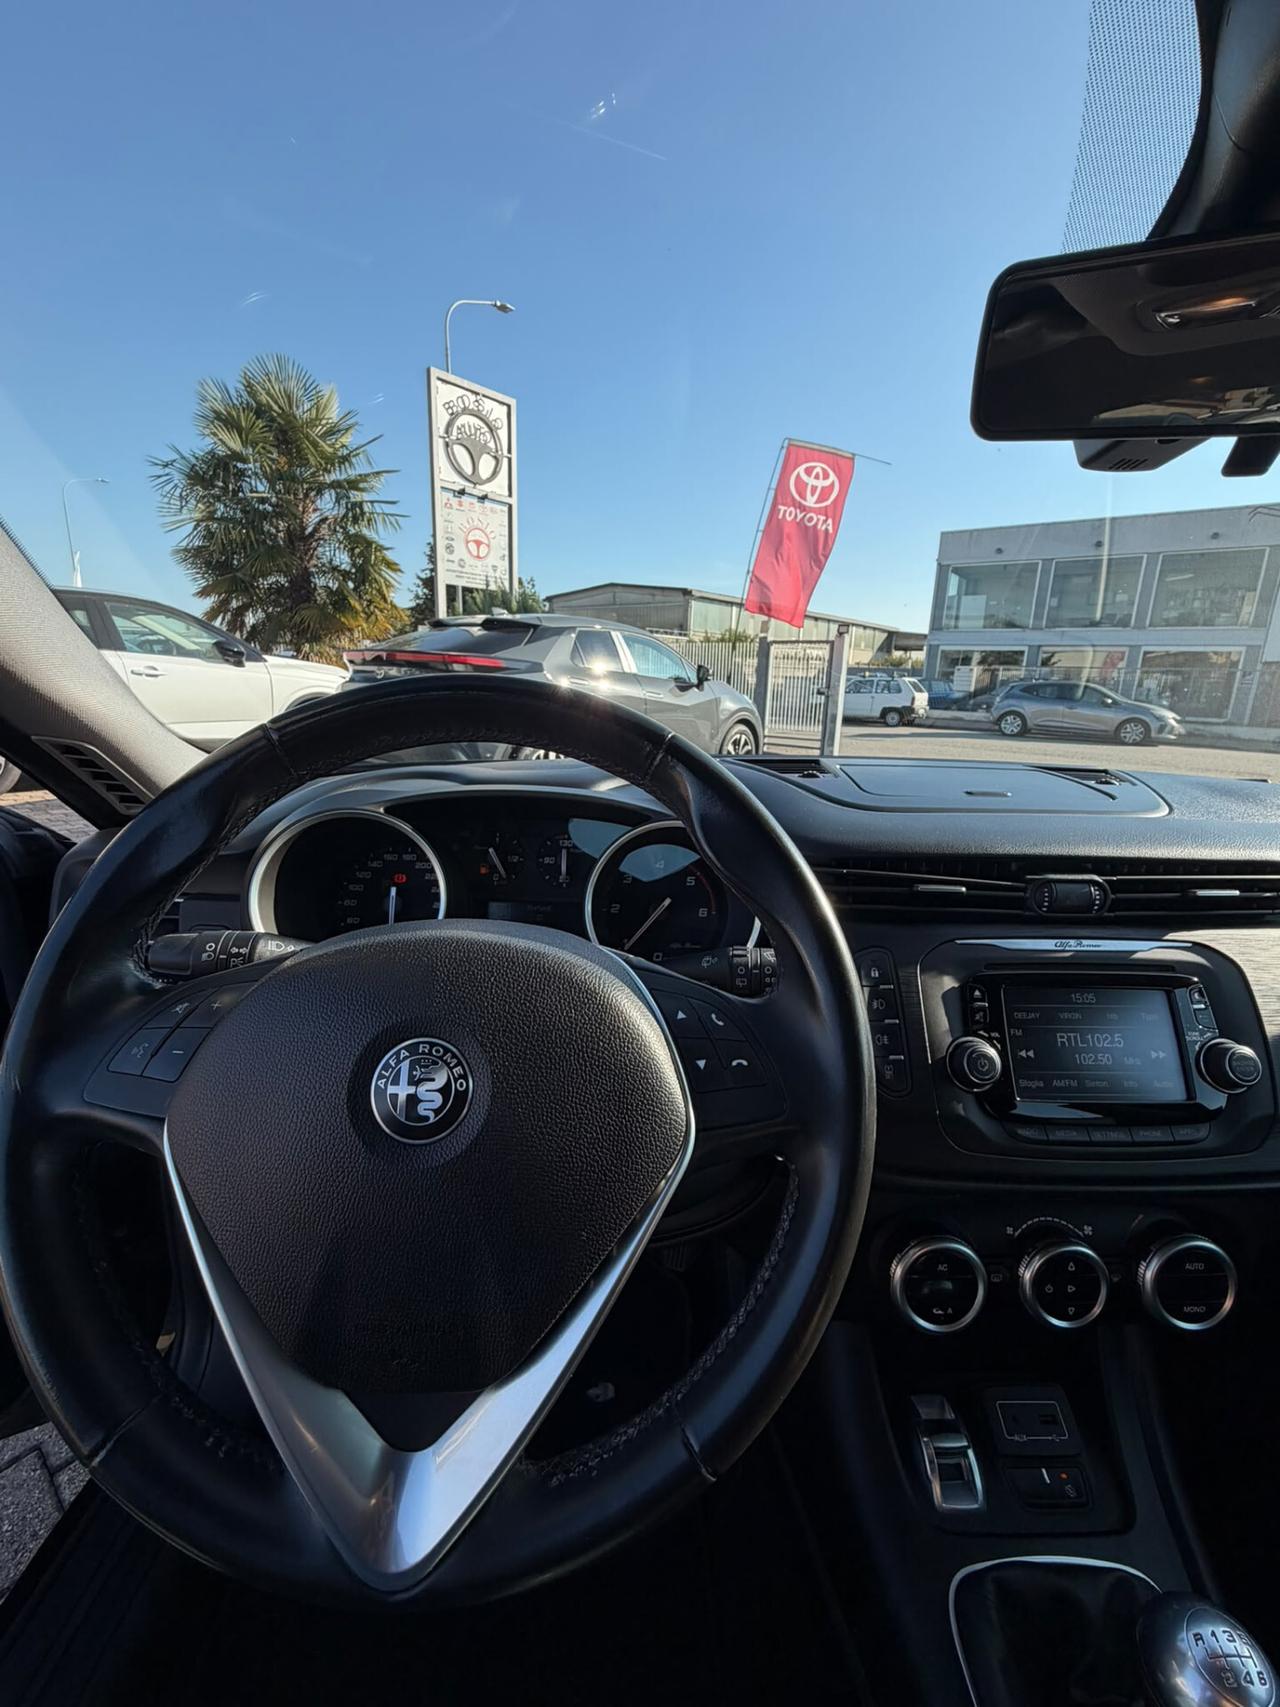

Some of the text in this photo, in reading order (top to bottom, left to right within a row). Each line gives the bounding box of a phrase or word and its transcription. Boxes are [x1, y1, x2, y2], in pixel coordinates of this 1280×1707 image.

[777, 505, 833, 533] TOYOTA
[655, 860, 665, 869] 4
[622, 875, 633, 884] 3
[686, 876, 696, 886] 5
[610, 904, 621, 914] 2
[698, 908, 709, 918] 6
[1071, 993, 1097, 1004] 15:05
[1056, 1033, 1125, 1048] RTL102.5
[1075, 1053, 1113, 1065] 102.50
[377, 1043, 467, 1092] ALFA ROMEO
[937, 1263, 949, 1272] AC
[1185, 1263, 1205, 1271] AUTO
[1183, 1306, 1205, 1314] MONO
[1192, 1632, 1205, 1647] R
[1210, 1630, 1219, 1644] 1
[1221, 1629, 1237, 1644] 3
[1241, 1670, 1255, 1687] 4
[1256, 1670, 1268, 1687] 6
